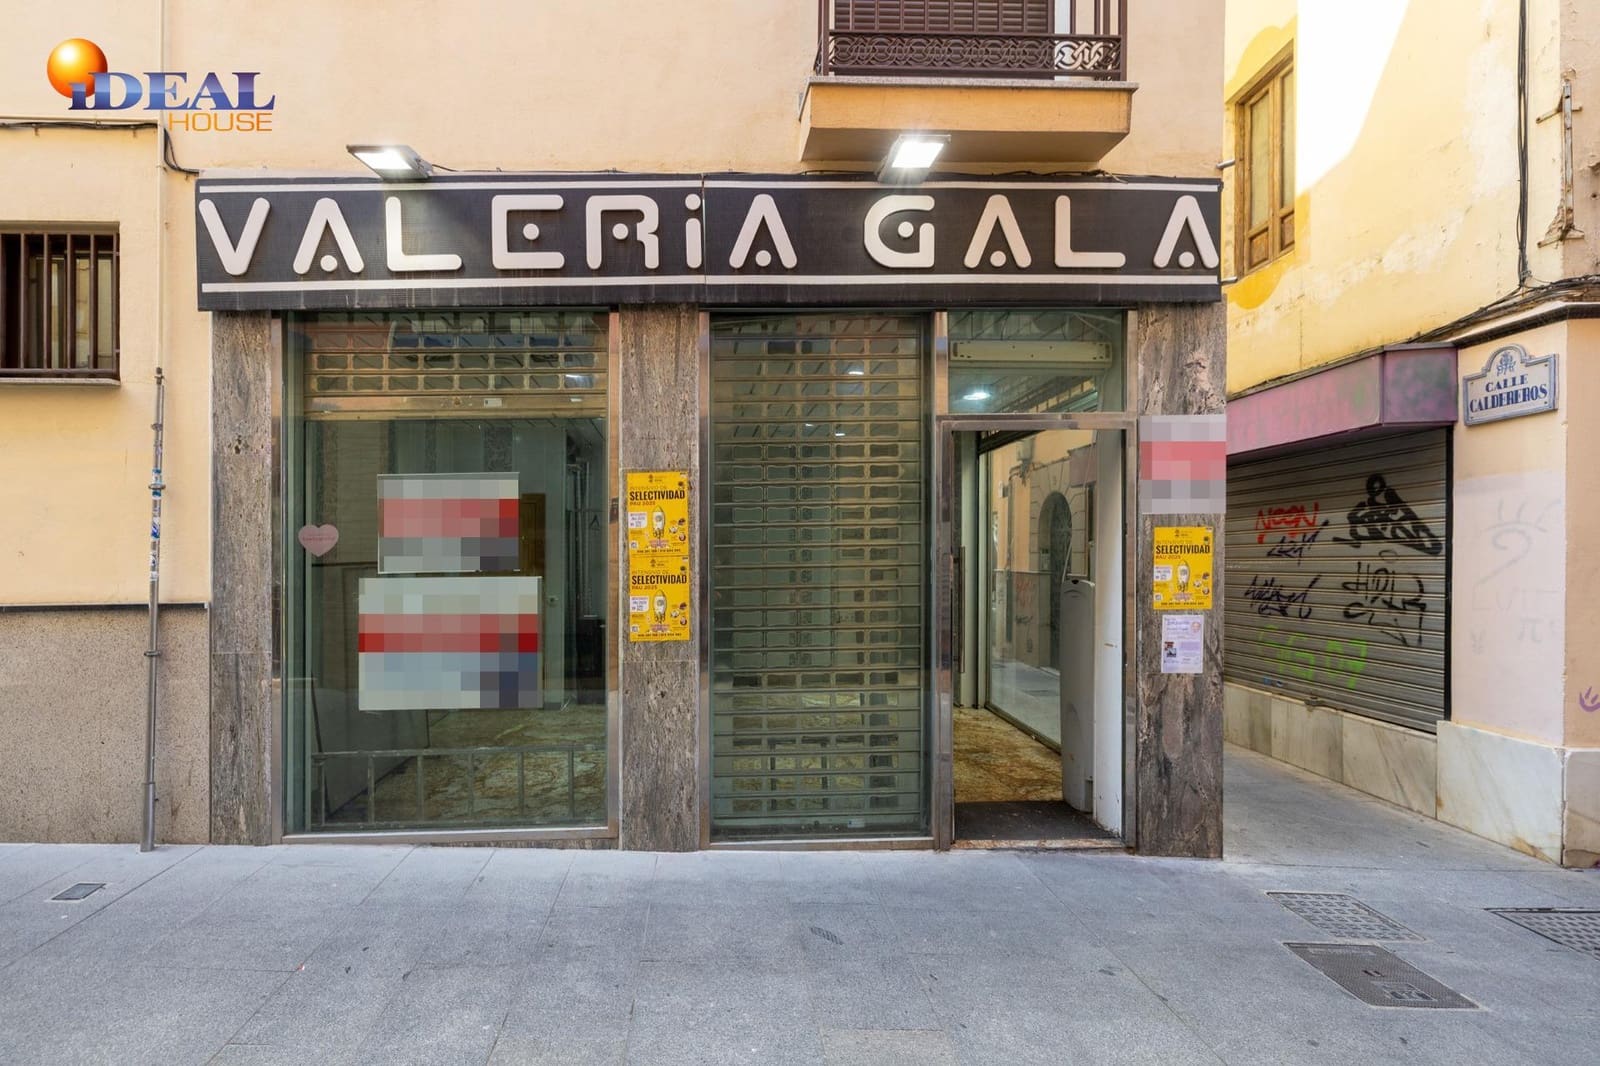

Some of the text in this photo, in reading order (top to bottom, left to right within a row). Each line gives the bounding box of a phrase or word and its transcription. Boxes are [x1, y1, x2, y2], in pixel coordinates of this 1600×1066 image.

[863, 193, 1220, 270] GALA
[1485, 373, 1529, 393] CALLE
[1469, 383, 1548, 413] CALDEREROS
[629, 489, 686, 501] SELECTIVIDAD
[1155, 544, 1211, 555] SELECTIVIDAD
[631, 574, 688, 585] SELECTIVIDAD
